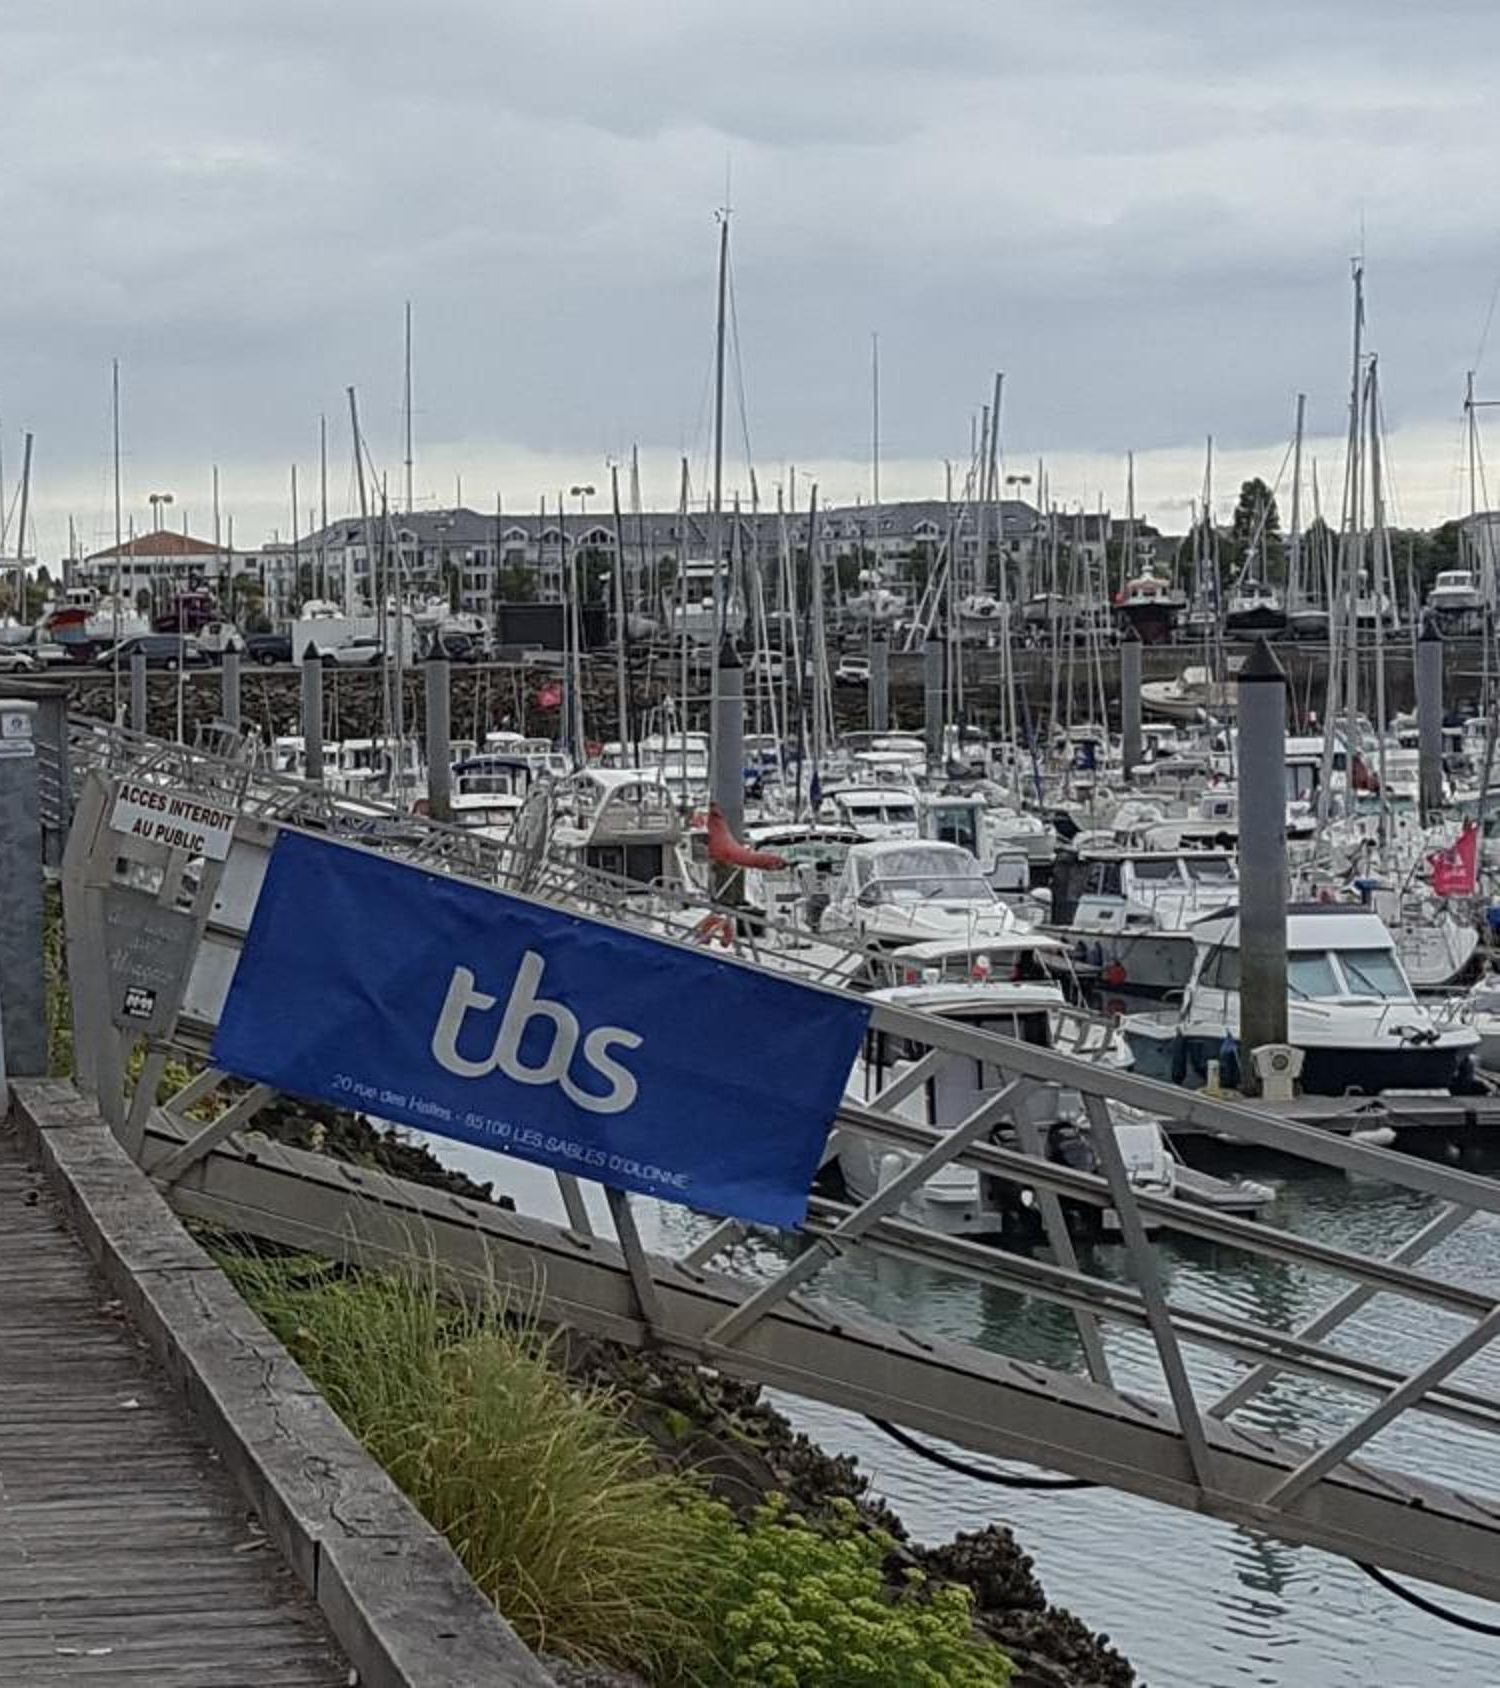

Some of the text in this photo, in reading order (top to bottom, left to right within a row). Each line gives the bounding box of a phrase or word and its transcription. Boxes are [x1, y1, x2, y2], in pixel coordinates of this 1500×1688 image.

[119, 785, 233, 831] ACCES INTERDIT
[132, 818, 205, 851] AU PUBLIC
[432, 950, 644, 1114] tbs
[332, 1073, 352, 1091] 20
[353, 1083, 377, 1098] rue
[380, 1090, 405, 1107] des
[408, 1096, 451, 1120] Halles
[465, 1113, 511, 1137] 85100
[514, 1128, 543, 1147] LES
[545, 1137, 606, 1167] SABLES
[609, 1156, 689, 1189] D'OLONNE
